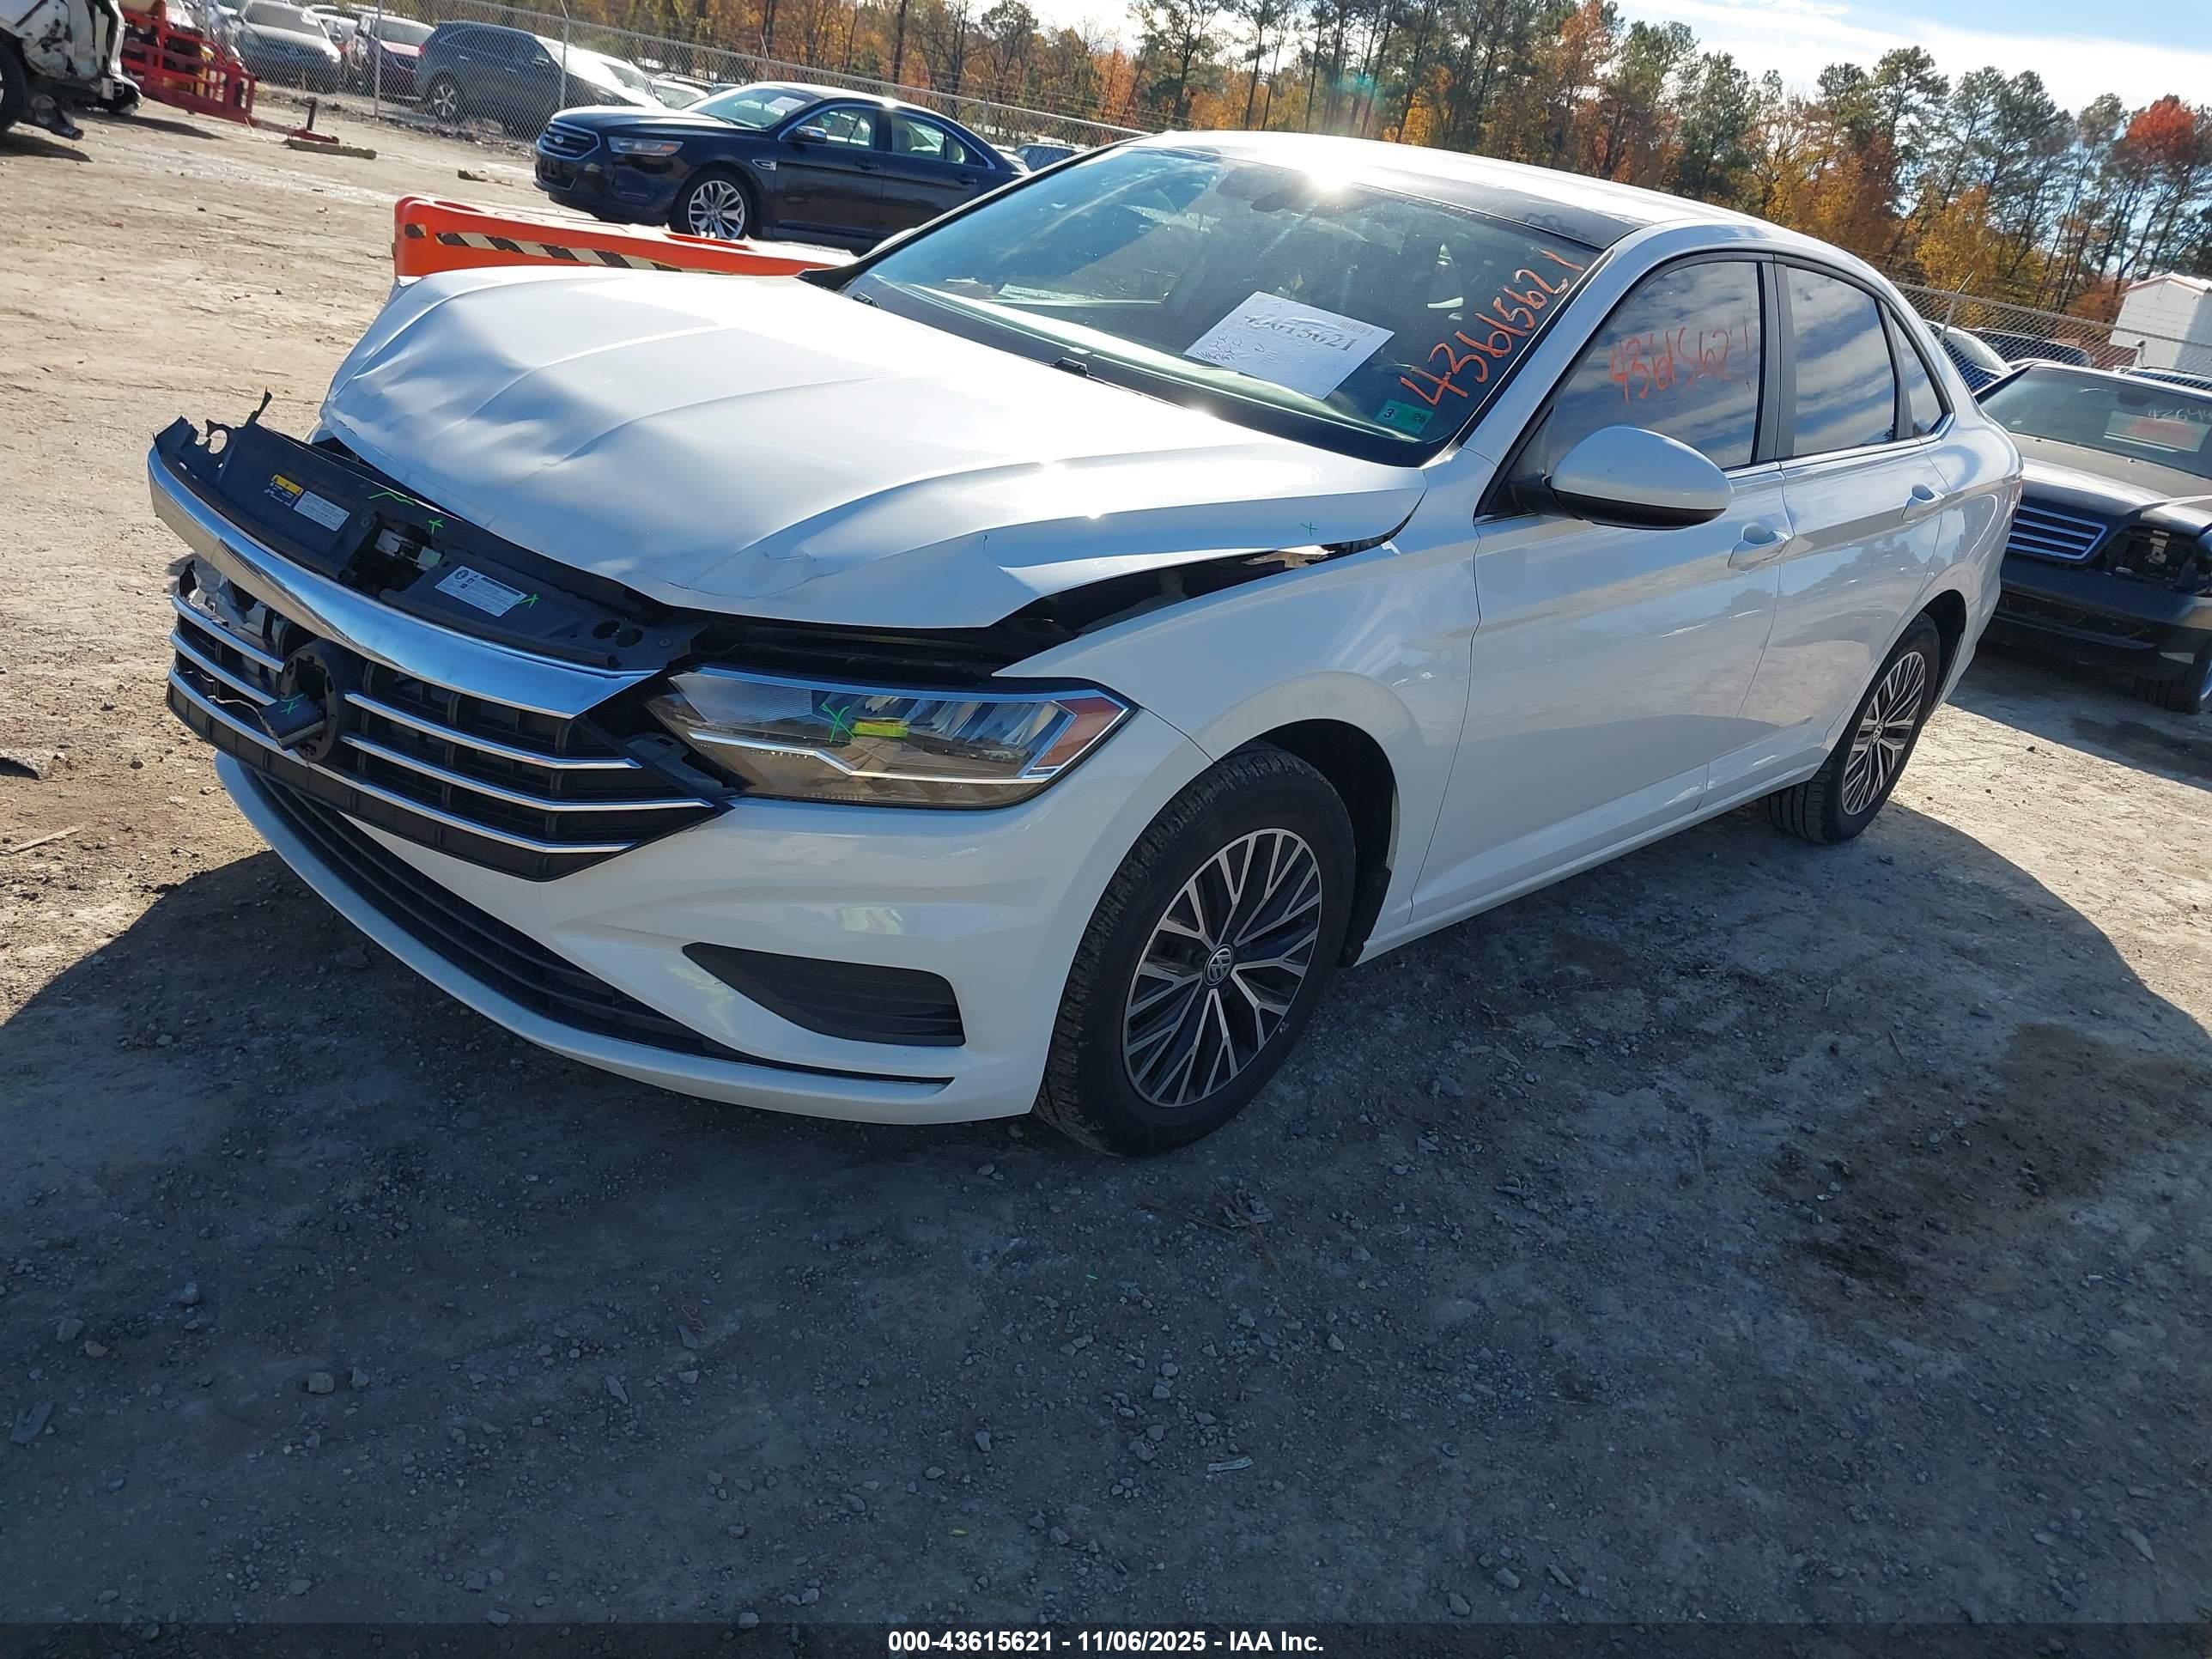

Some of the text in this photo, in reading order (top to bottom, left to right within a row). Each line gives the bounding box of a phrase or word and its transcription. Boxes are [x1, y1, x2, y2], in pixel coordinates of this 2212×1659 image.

[1395, 246, 1584, 405] 43615621
[1608, 314, 1752, 404] 43615621
[1383, 408, 1395, 418] 3
